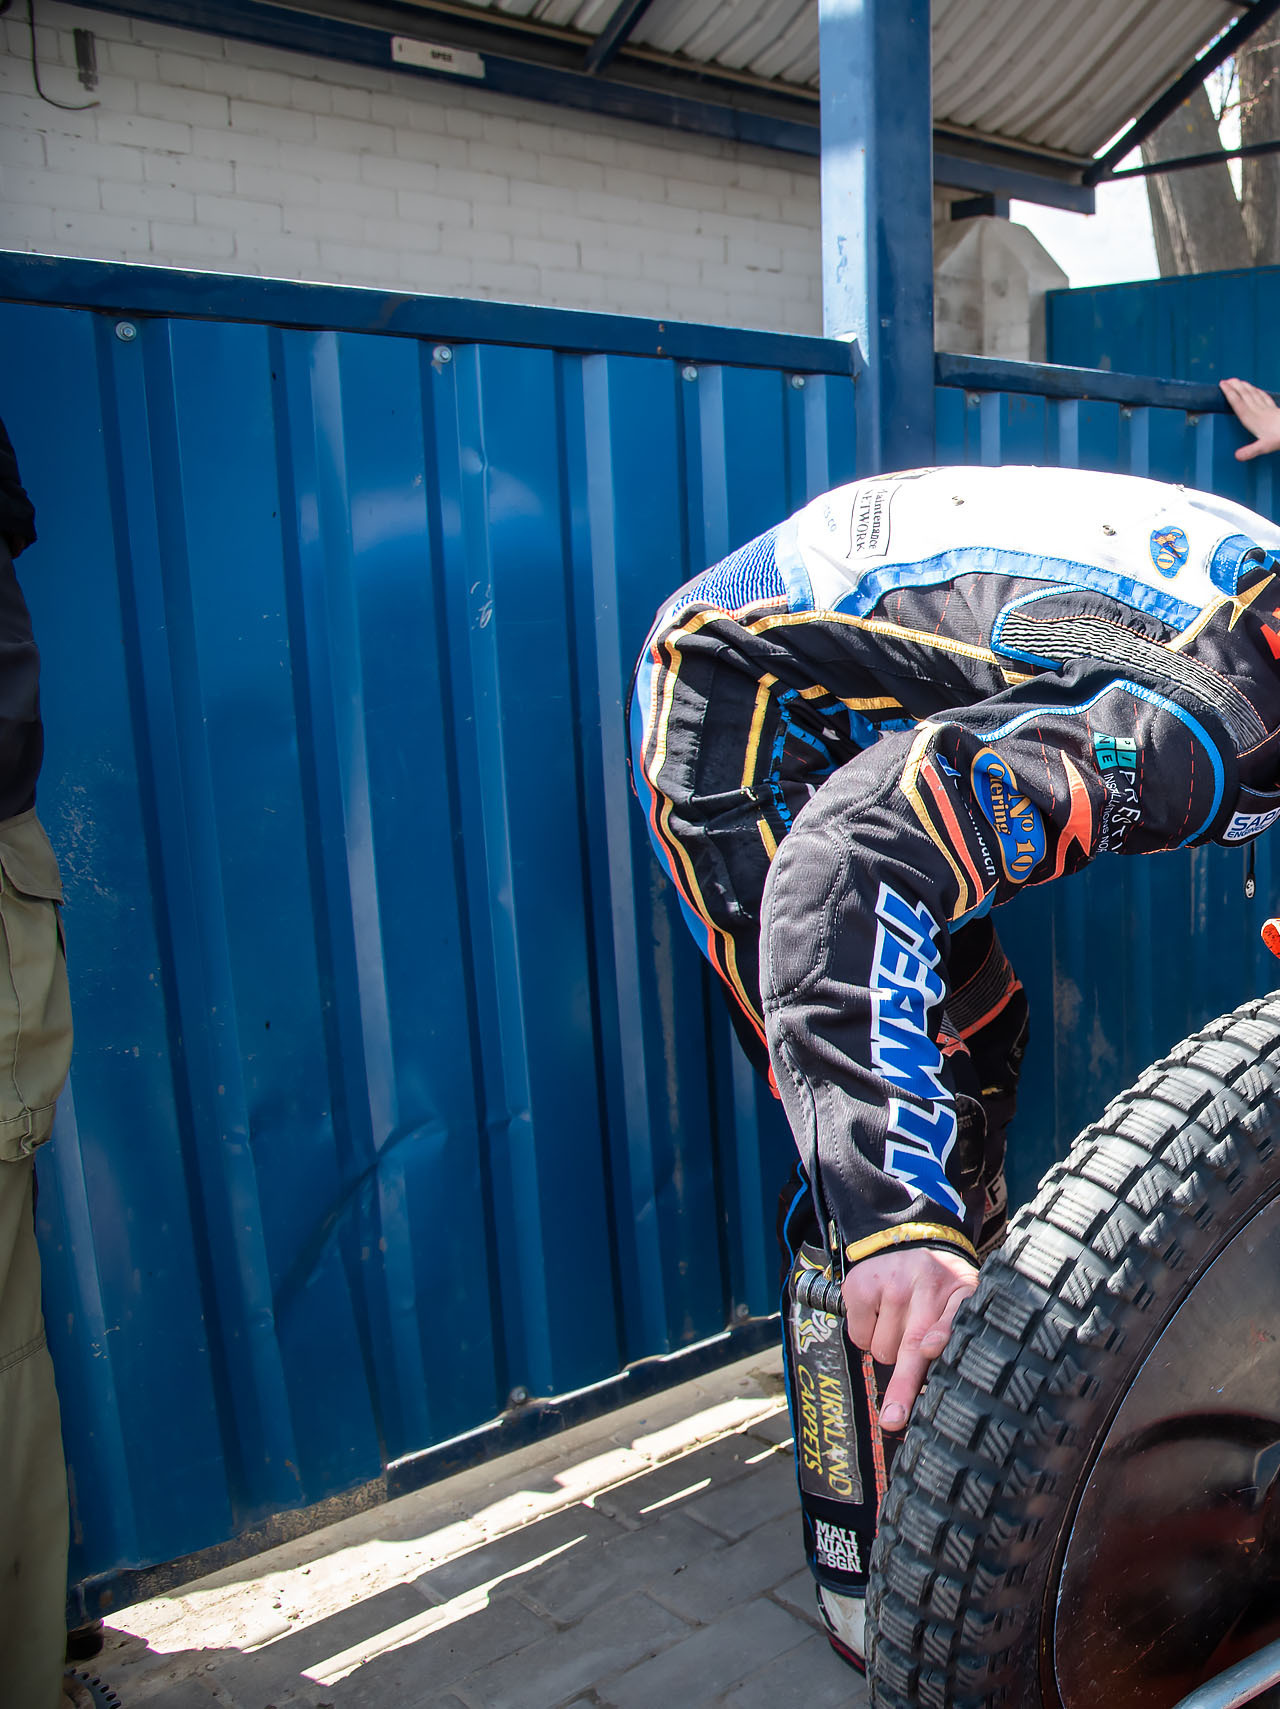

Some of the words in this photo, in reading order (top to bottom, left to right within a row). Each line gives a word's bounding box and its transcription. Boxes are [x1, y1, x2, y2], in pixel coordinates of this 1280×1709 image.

[1011, 839, 1036, 872] 10
[797, 1364, 824, 1476] CARPETS
[818, 1373, 853, 1497] KIRKLAND
